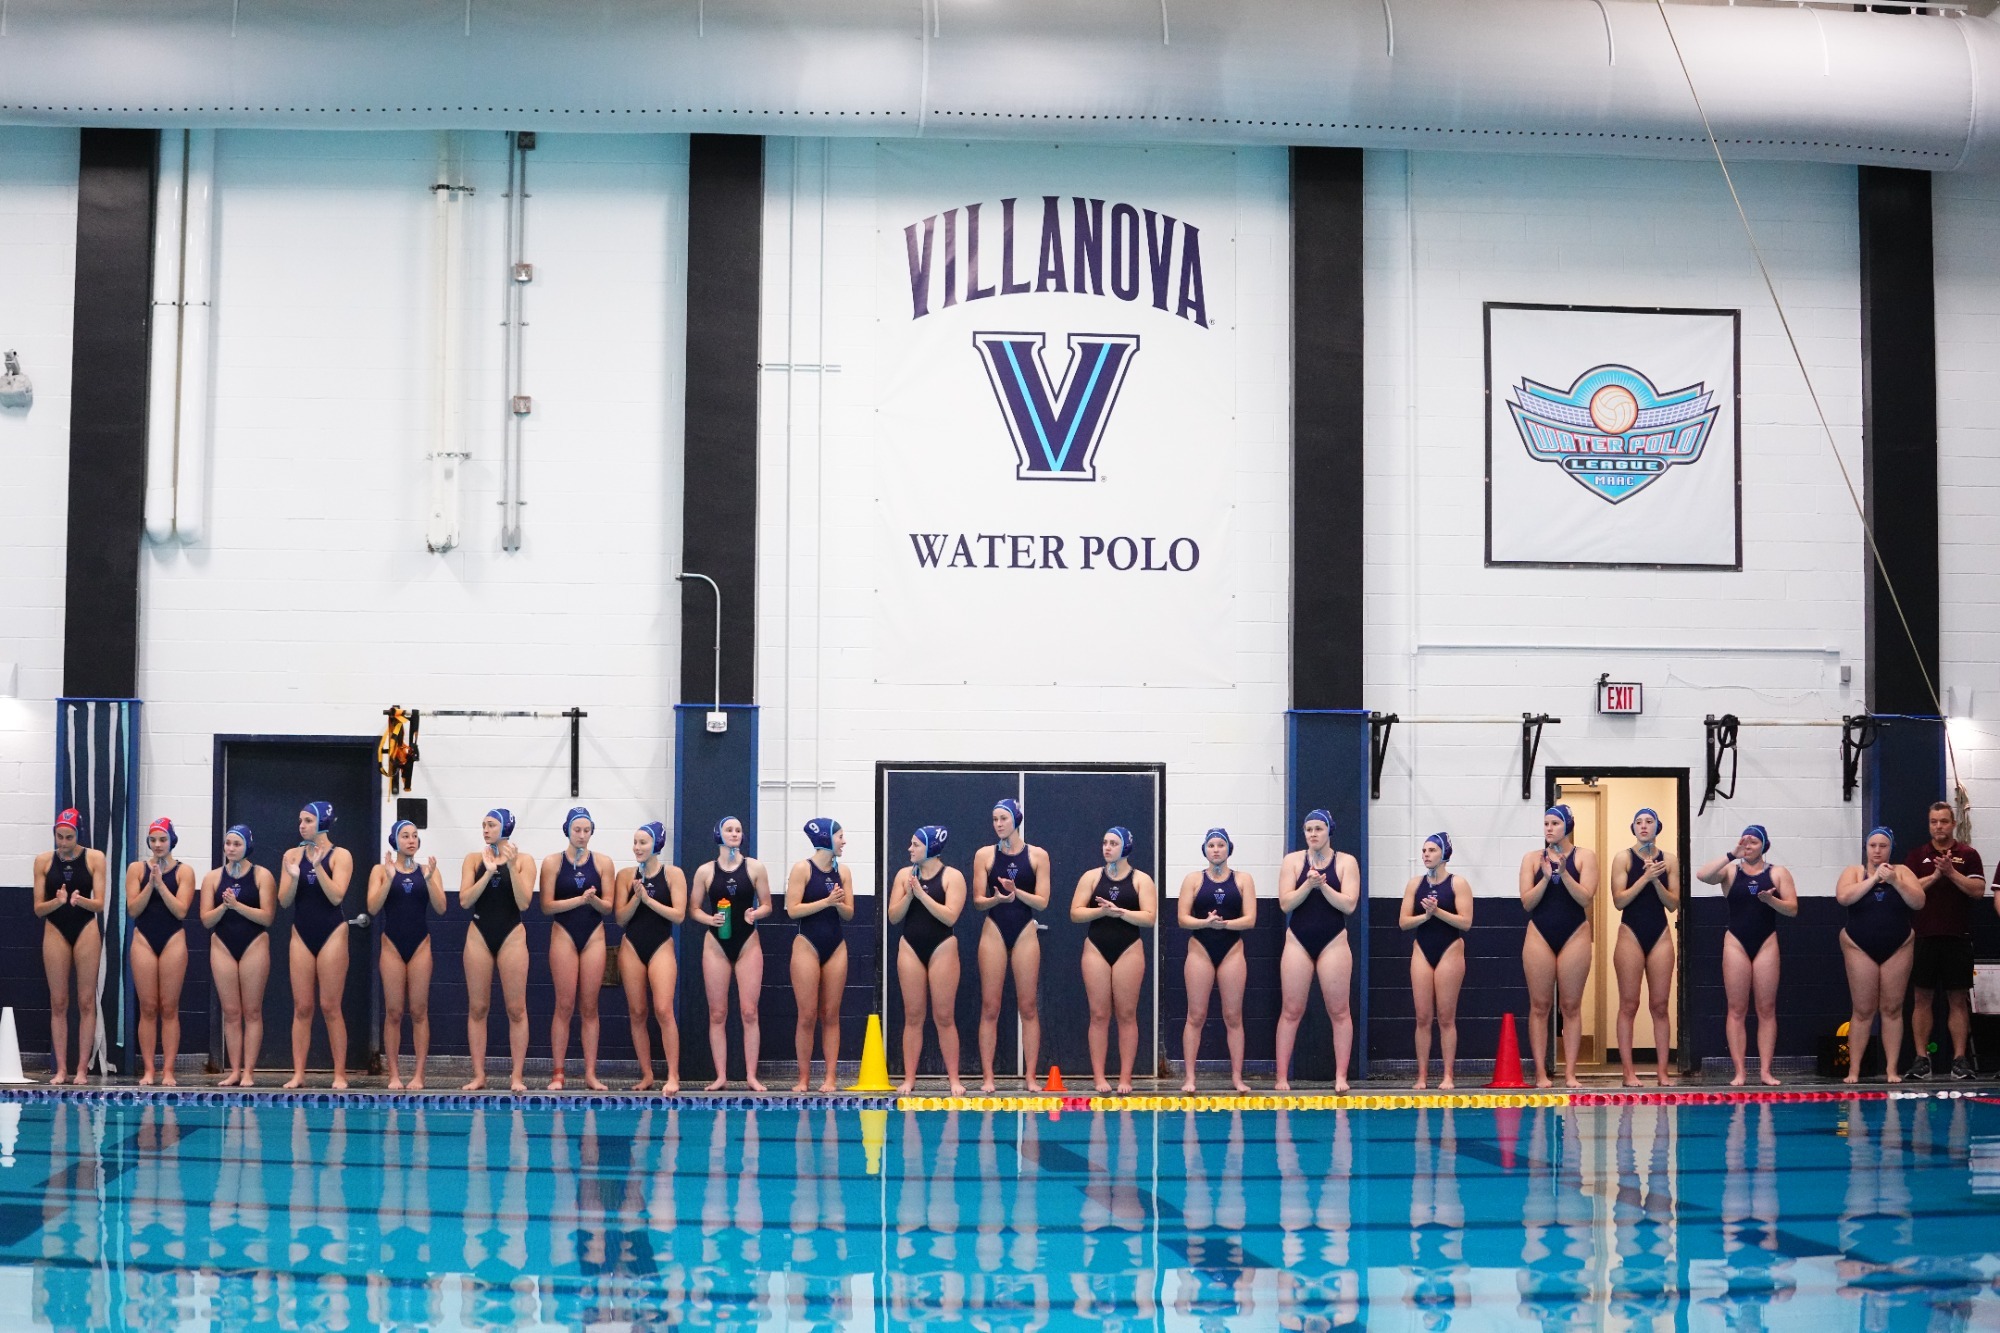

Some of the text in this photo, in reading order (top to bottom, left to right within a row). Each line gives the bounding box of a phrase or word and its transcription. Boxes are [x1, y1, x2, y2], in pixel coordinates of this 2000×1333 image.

[904, 195, 1209, 330] VILLANOVA
[972, 331, 1140, 481] V
[1527, 421, 1703, 455] WATER POLO
[1571, 460, 1658, 470] LEAGUE
[1594, 475, 1635, 486] MAAC
[909, 532, 1200, 572] WATER POLO
[1608, 686, 1634, 709] EXIT
[809, 822, 820, 834] 9
[935, 828, 948, 842] 10
